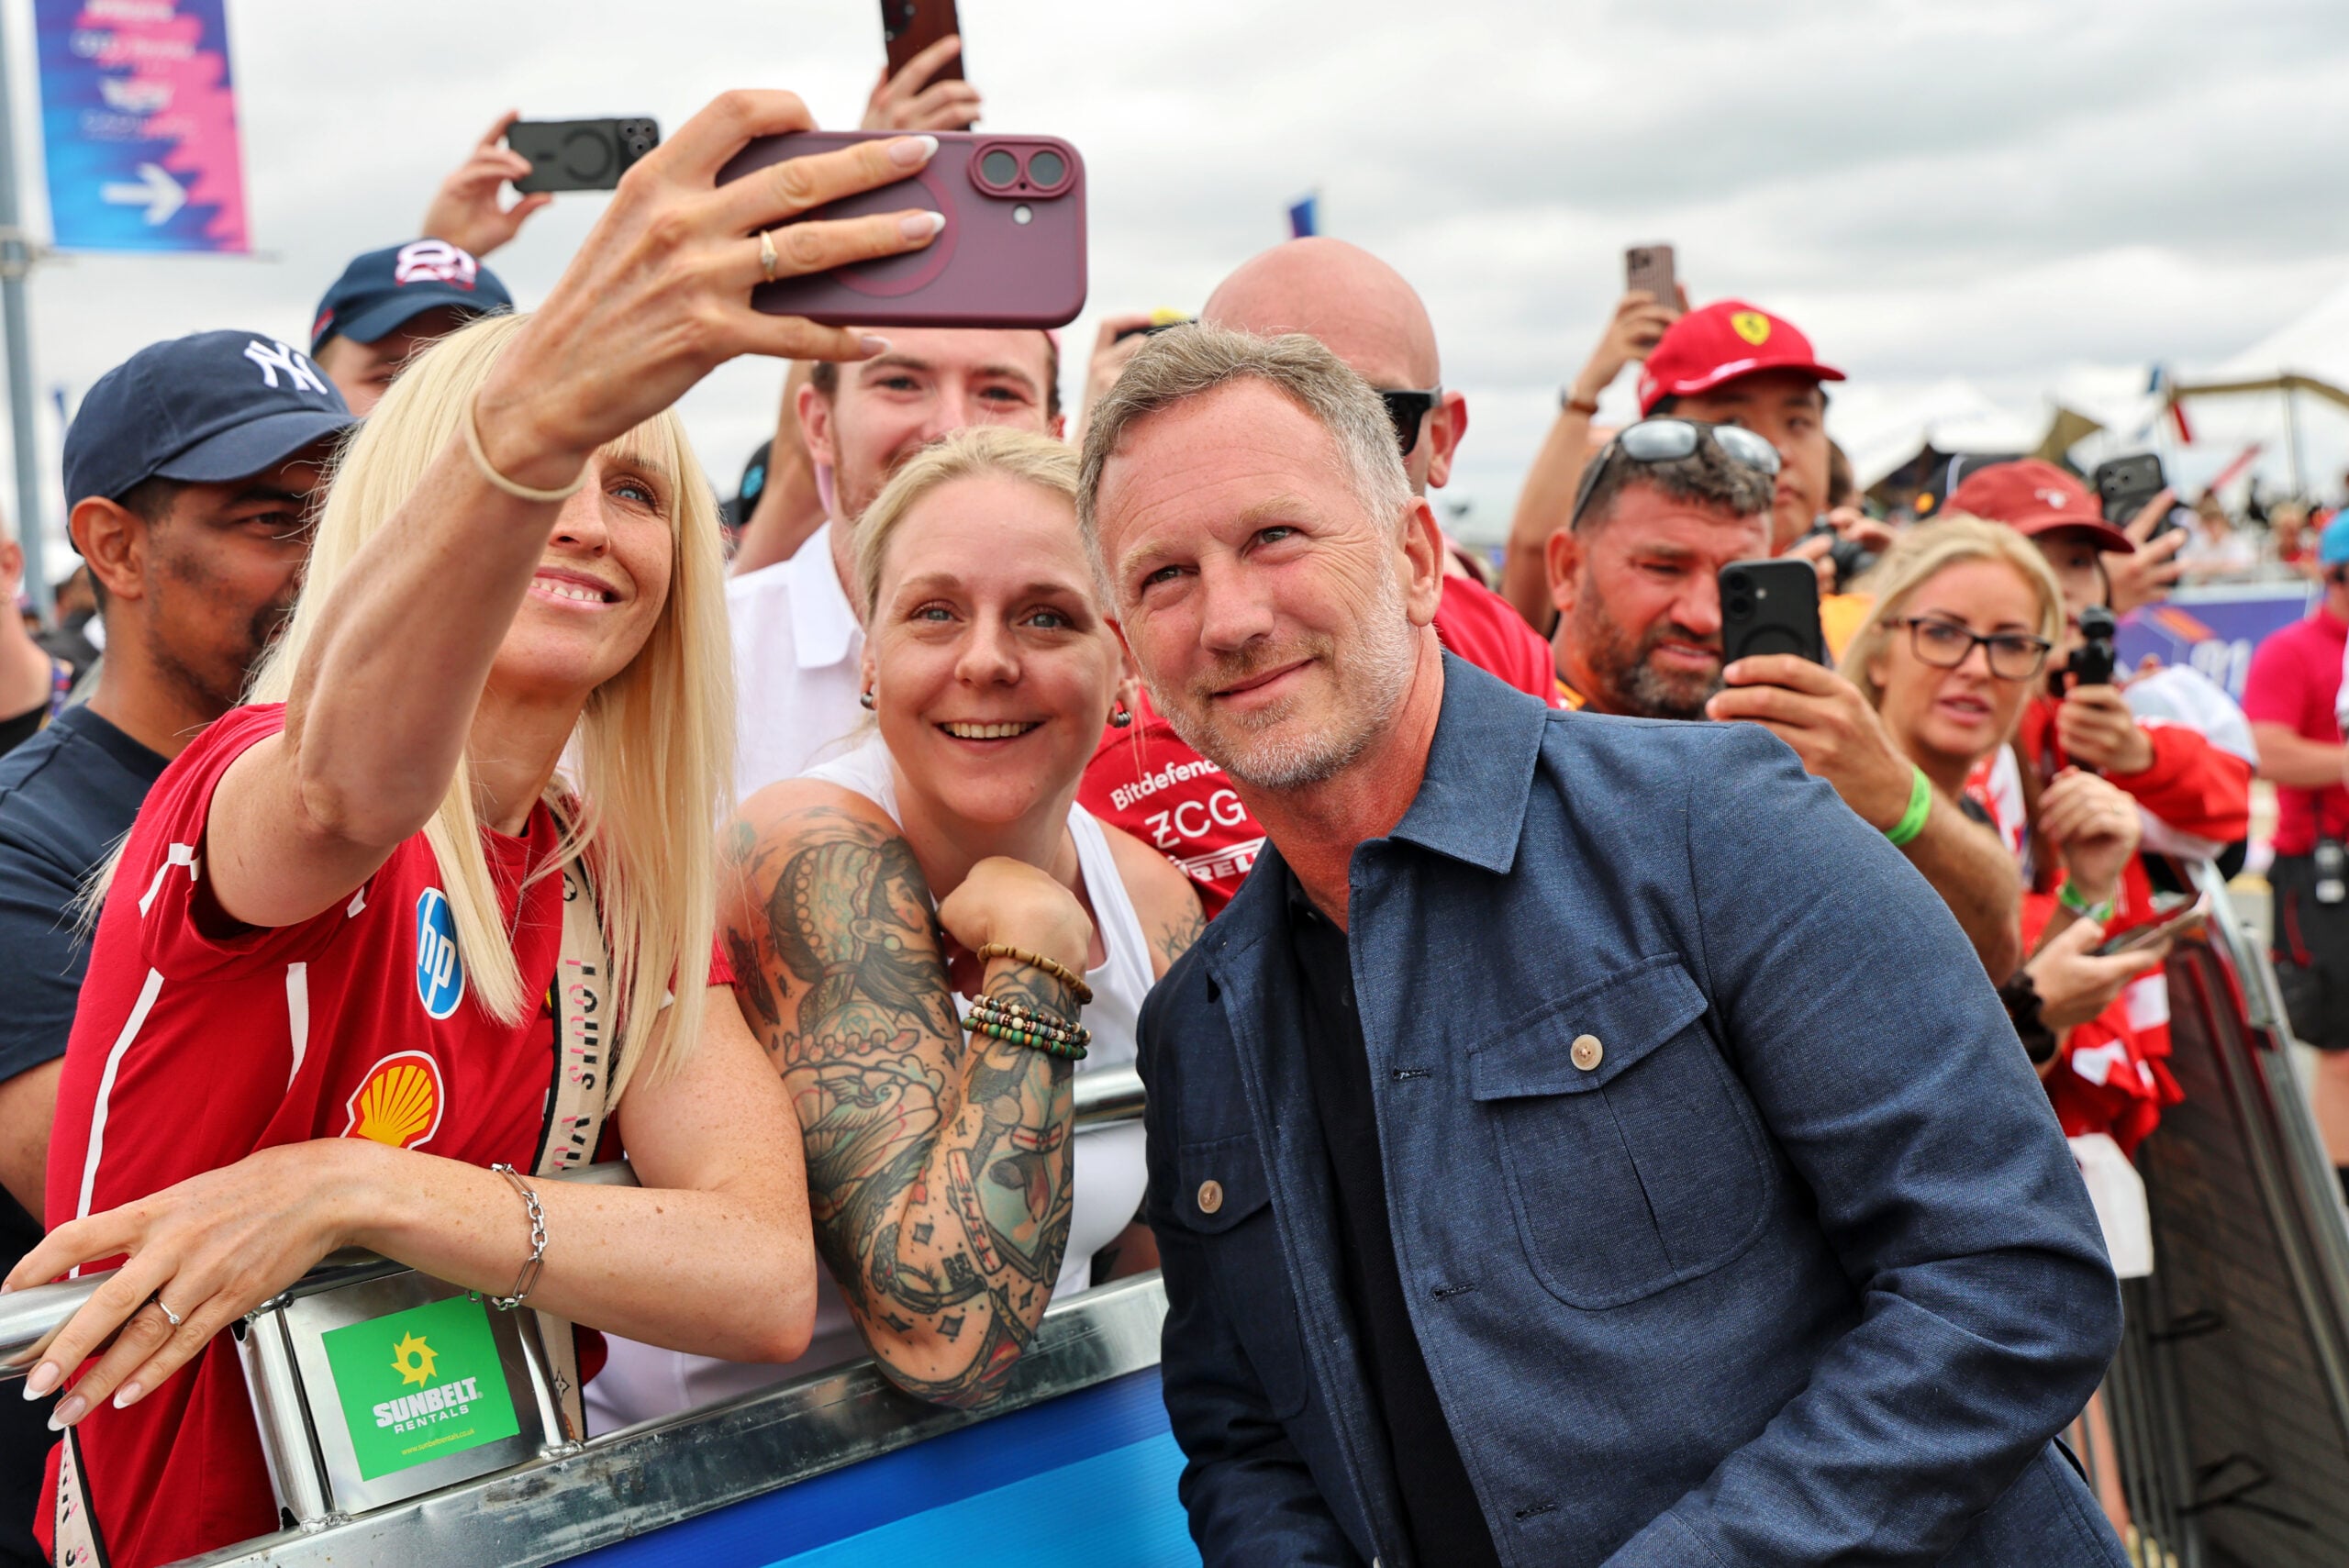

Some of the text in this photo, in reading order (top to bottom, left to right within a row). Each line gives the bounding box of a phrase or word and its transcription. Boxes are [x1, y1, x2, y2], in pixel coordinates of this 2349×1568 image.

[1144, 789, 1247, 849] ZCG
[417, 892, 457, 1014] hp
[373, 1376, 477, 1428] SUNBELT
[394, 1404, 470, 1434] RENTALS
